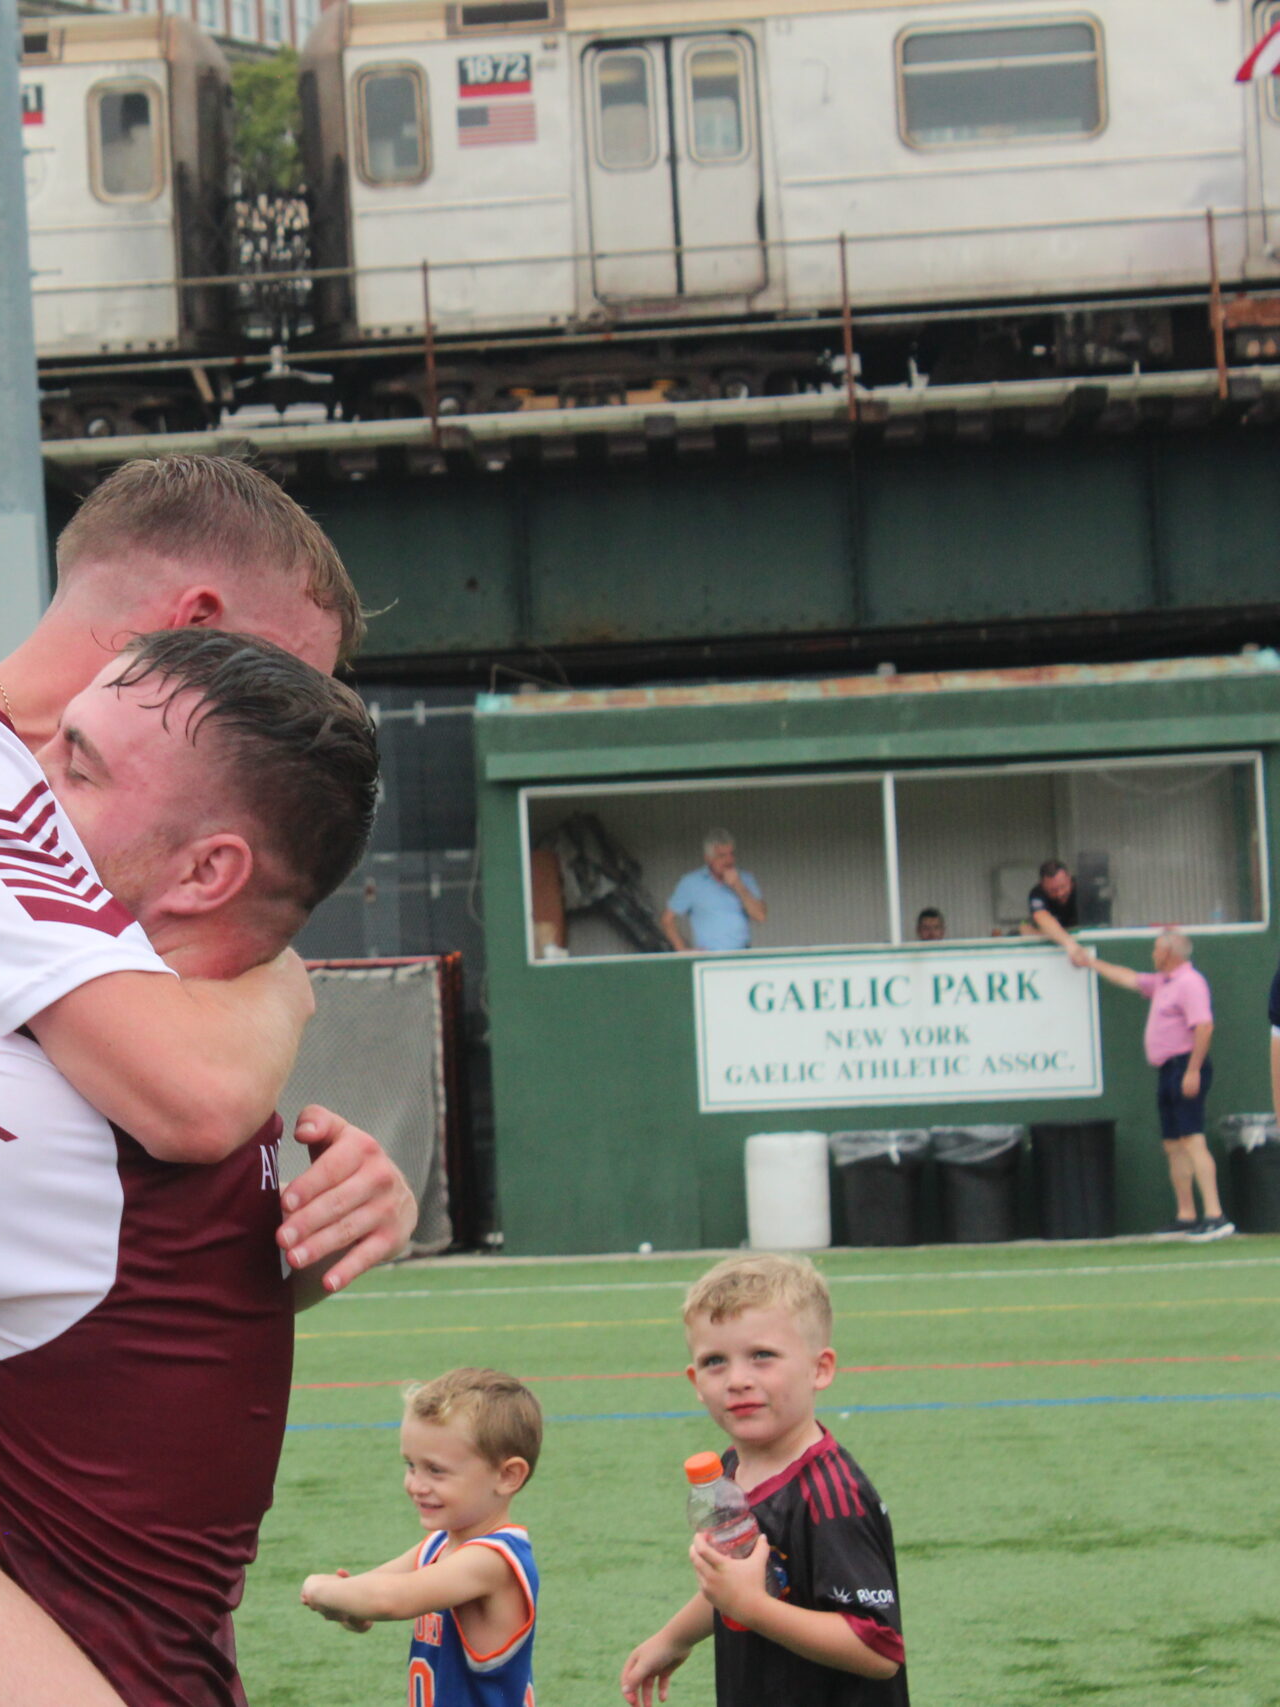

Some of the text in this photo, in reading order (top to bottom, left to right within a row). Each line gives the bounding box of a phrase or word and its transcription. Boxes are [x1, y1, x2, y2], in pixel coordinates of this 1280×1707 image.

[463, 54, 528, 84] 1872
[747, 969, 1043, 1014] GAELIC PARK
[825, 1024, 972, 1051] NEW YORK
[725, 1050, 1076, 1086] GAELIC ATHLETIC ASSOC.
